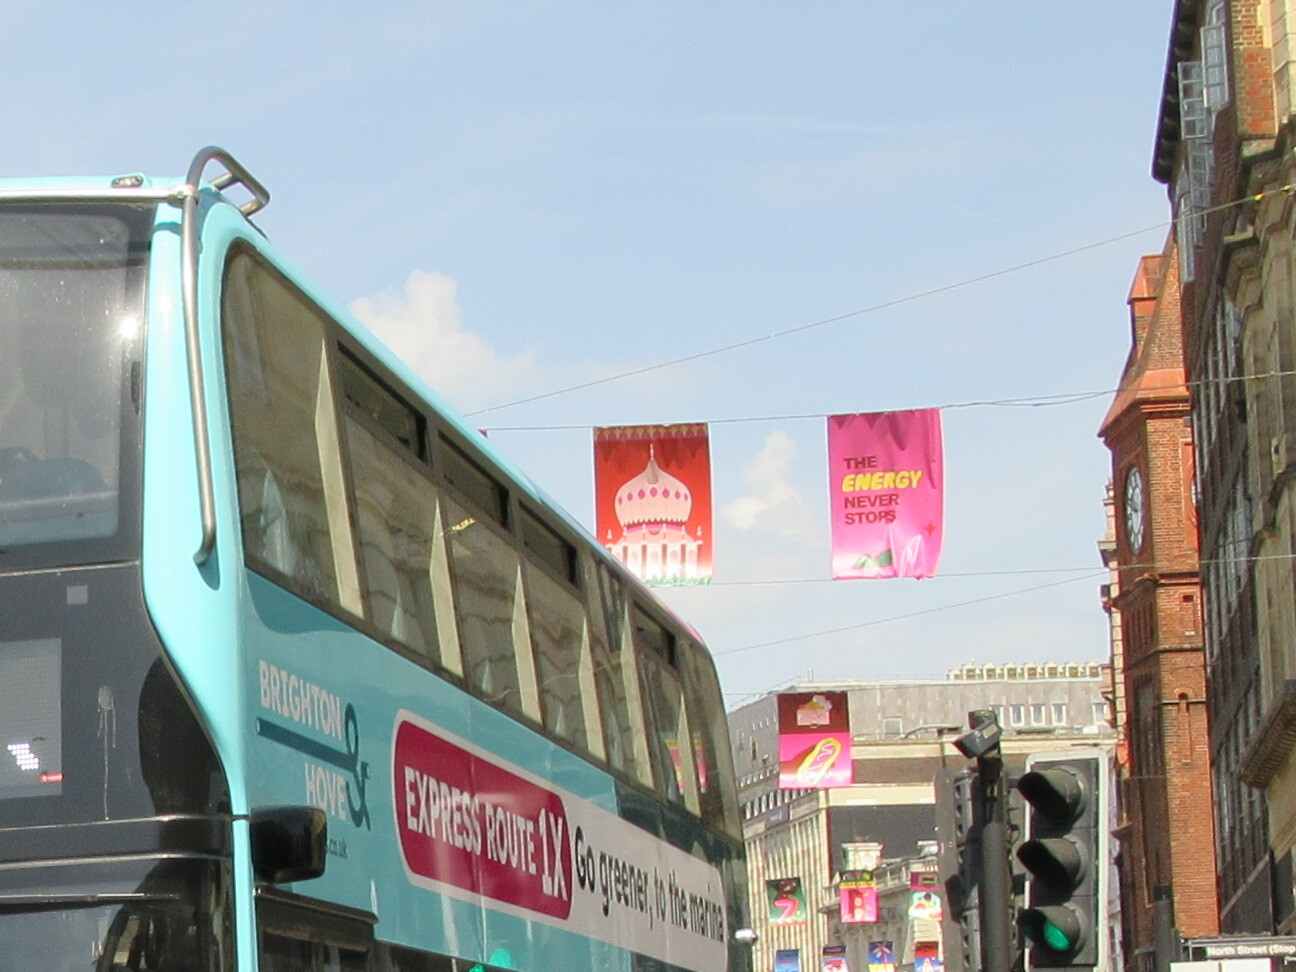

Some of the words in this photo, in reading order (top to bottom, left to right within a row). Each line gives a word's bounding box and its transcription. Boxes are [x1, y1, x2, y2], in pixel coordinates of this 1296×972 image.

[843, 456, 877, 469] THE
[841, 470, 923, 493] ENERGY
[844, 493, 899, 509] NEVER
[844, 510, 897, 525] STOPS
[258, 658, 343, 740] BRIGHTON
[305, 762, 347, 821] HOVE
[404, 765, 482, 856] EXPRESS
[484, 801, 537, 875] ROUTE
[538, 808, 569, 901] 1X
[575, 825, 596, 894] Go
[654, 866, 667, 922] to
[669, 868, 688, 930] the
[689, 883, 725, 943] marina
[1206, 946, 1236, 957] North
[1237, 944, 1267, 955] Street
